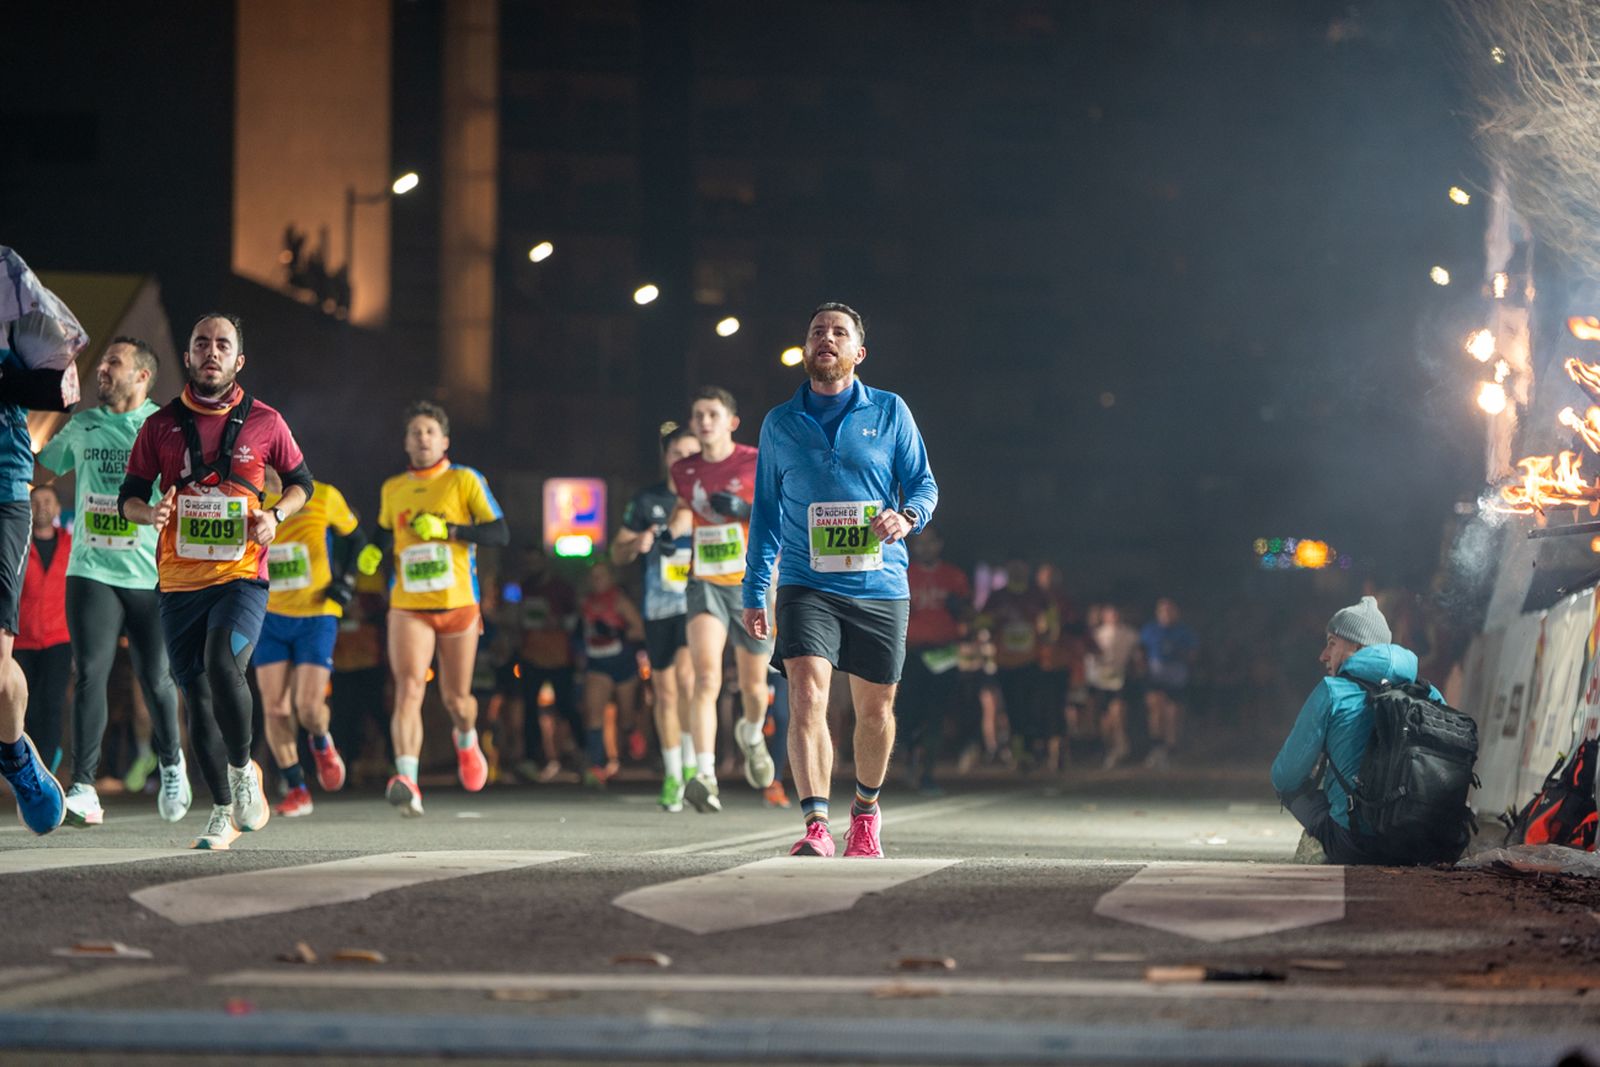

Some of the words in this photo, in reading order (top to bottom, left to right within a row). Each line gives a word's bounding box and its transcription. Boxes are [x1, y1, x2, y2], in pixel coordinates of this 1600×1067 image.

[93, 513, 129, 531] 8219
[824, 509, 847, 517] NOCHE
[189, 518, 235, 539] 8209
[816, 518, 831, 527] SAN
[825, 526, 869, 548] 7287
